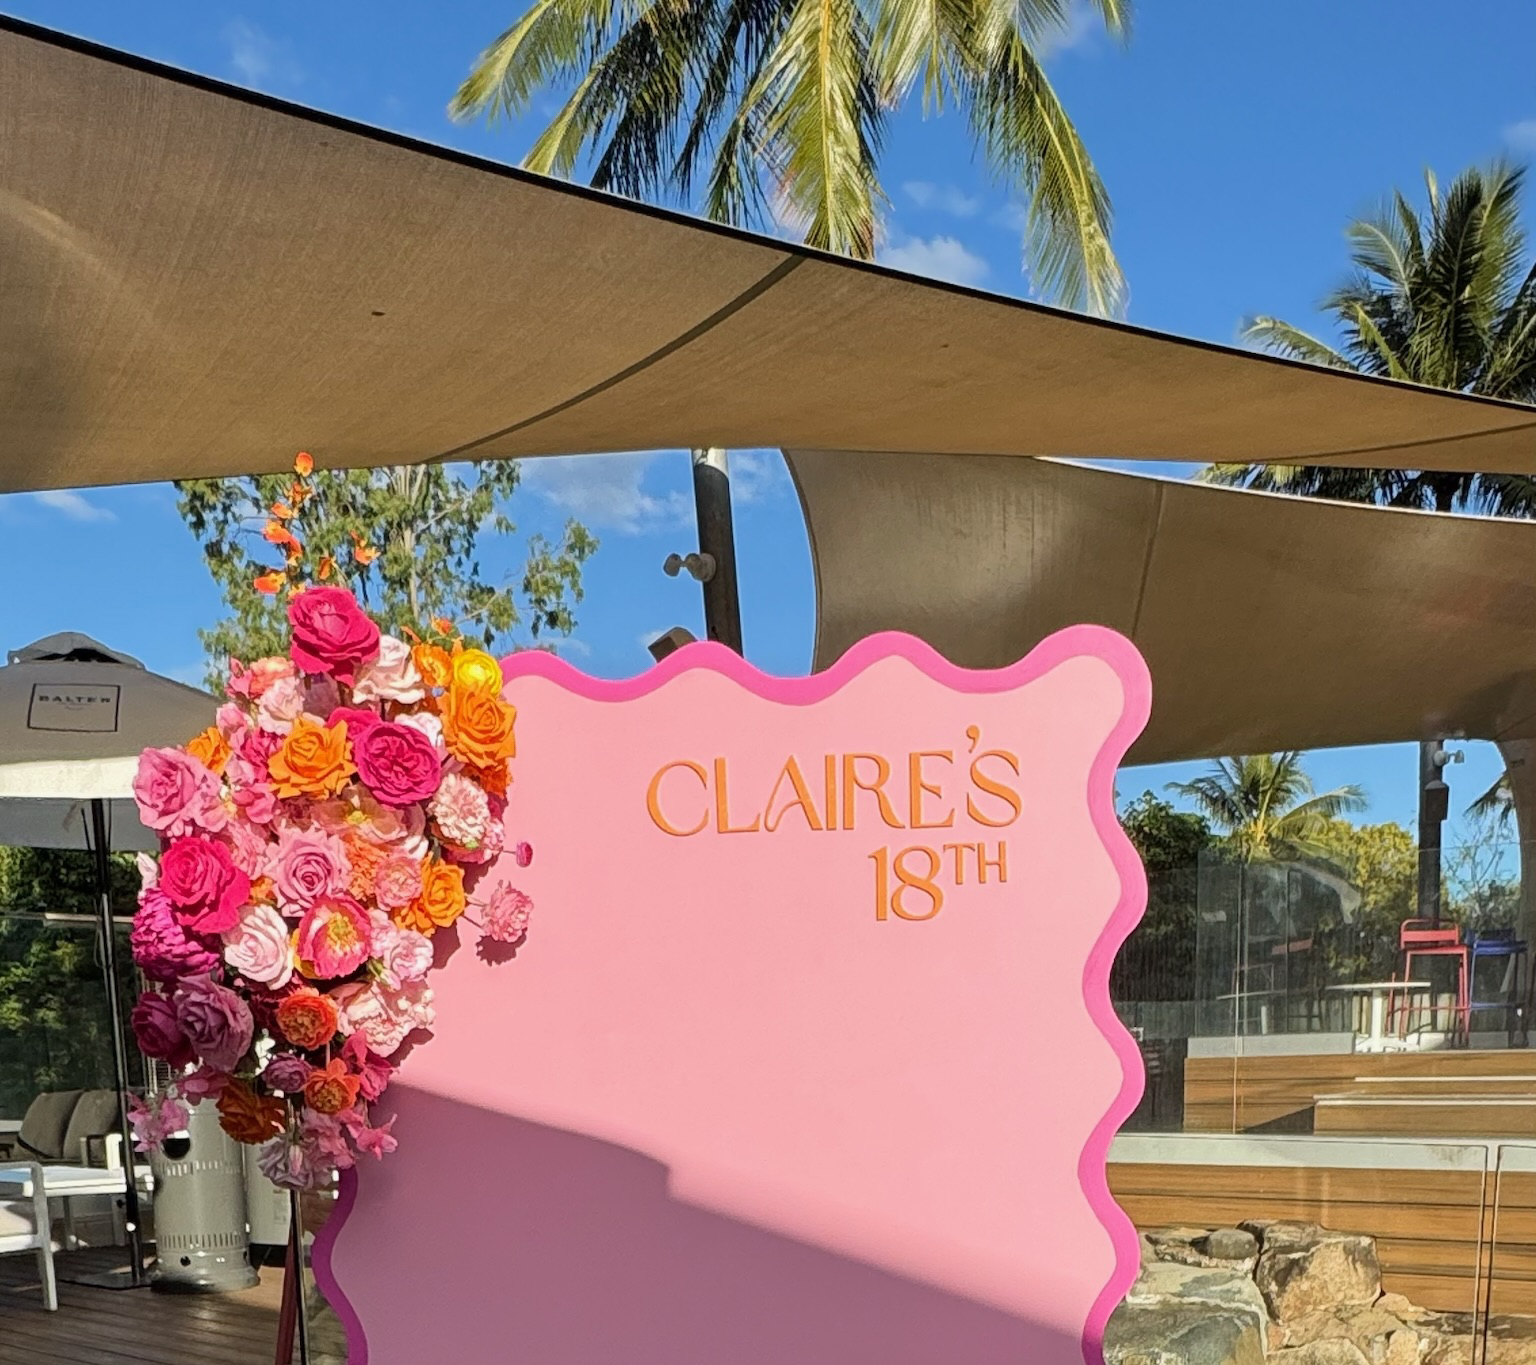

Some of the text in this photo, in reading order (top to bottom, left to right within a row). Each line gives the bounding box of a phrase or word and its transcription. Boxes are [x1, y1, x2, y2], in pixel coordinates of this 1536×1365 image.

[39, 695, 111, 703] BALTER
[646, 724, 1022, 837] CLAIRE'S
[867, 841, 1007, 921] 18TH
